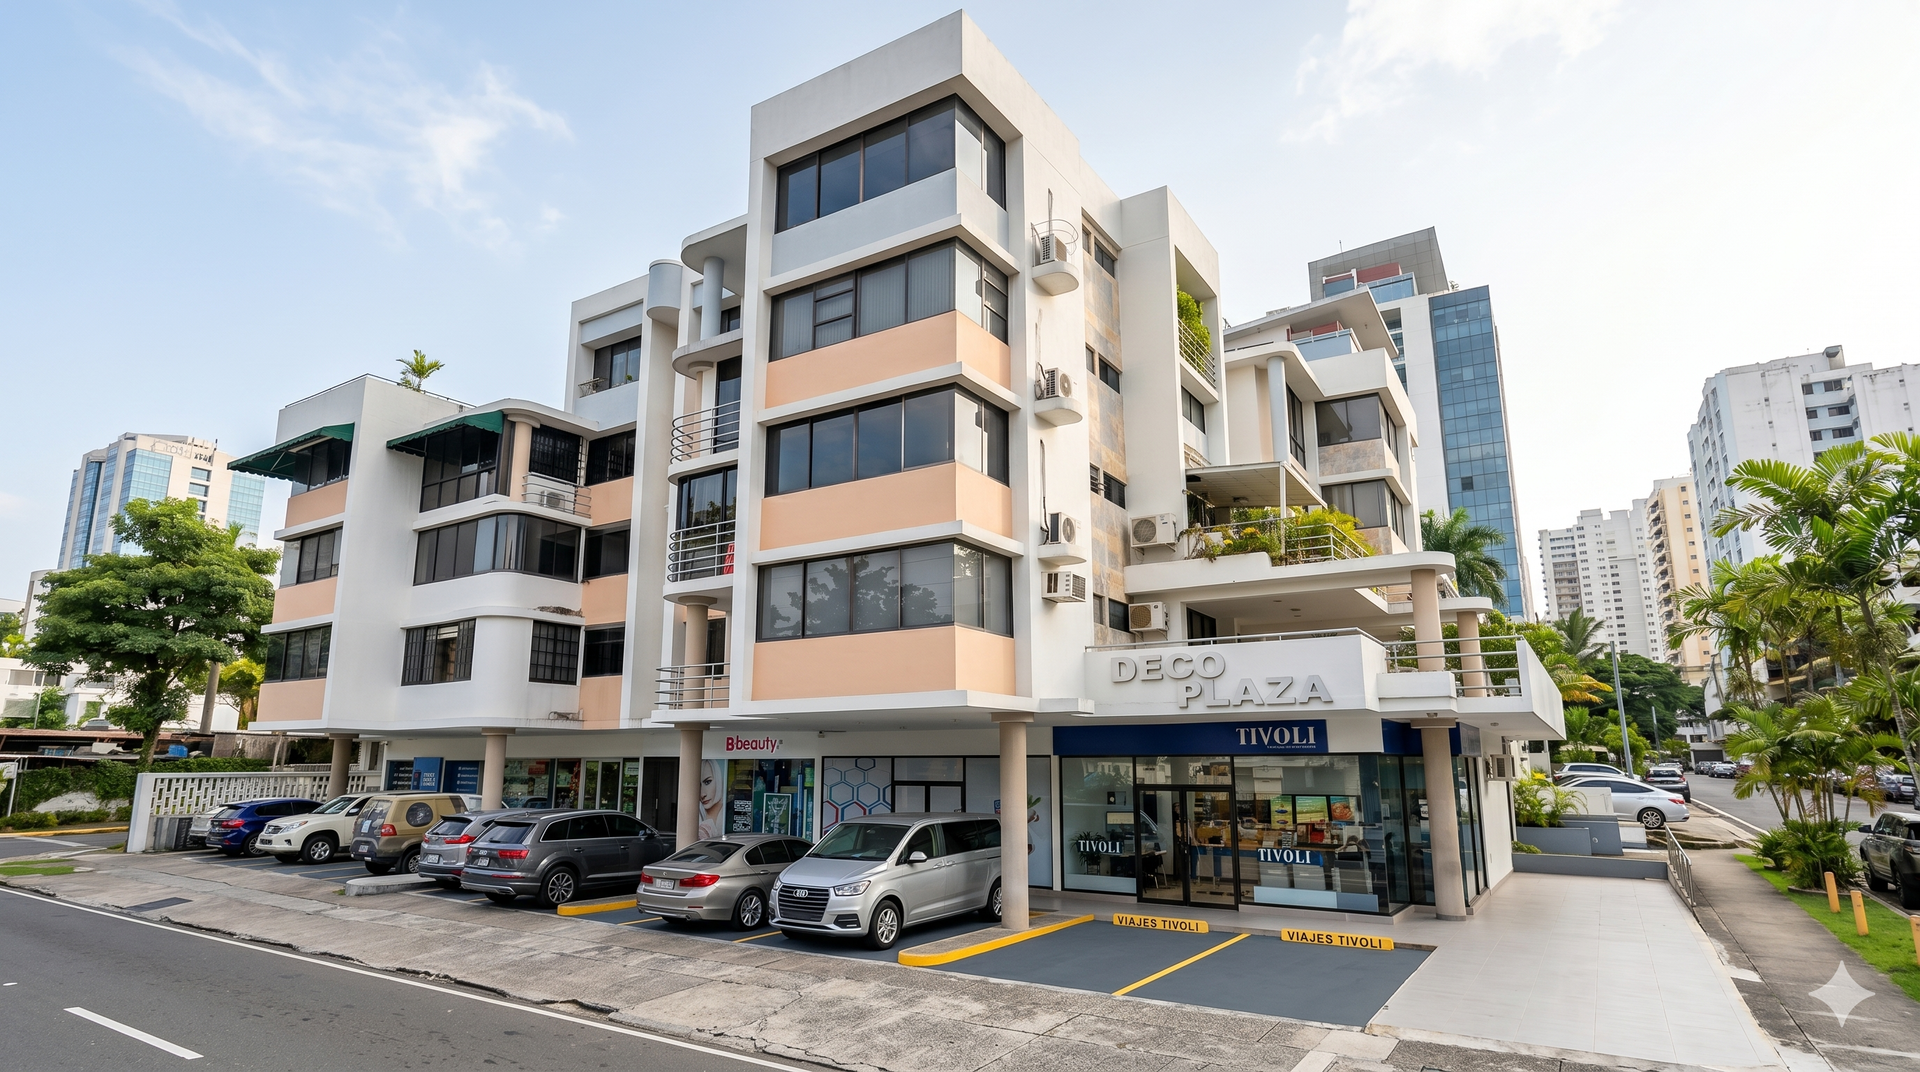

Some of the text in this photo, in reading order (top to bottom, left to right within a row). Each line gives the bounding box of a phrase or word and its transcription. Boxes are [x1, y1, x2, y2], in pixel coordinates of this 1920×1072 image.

[1111, 652, 1226, 683] DECO
[1177, 675, 1334, 709] PLAZA
[1235, 726, 1316, 746] TIVOLI
[1078, 839, 1120, 854] TIVOLI
[1257, 848, 1311, 864] TIVOLI
[1117, 915, 1199, 932] VIAJES TIVOLI
[1287, 930, 1382, 949] VIAJES TIVOLI
